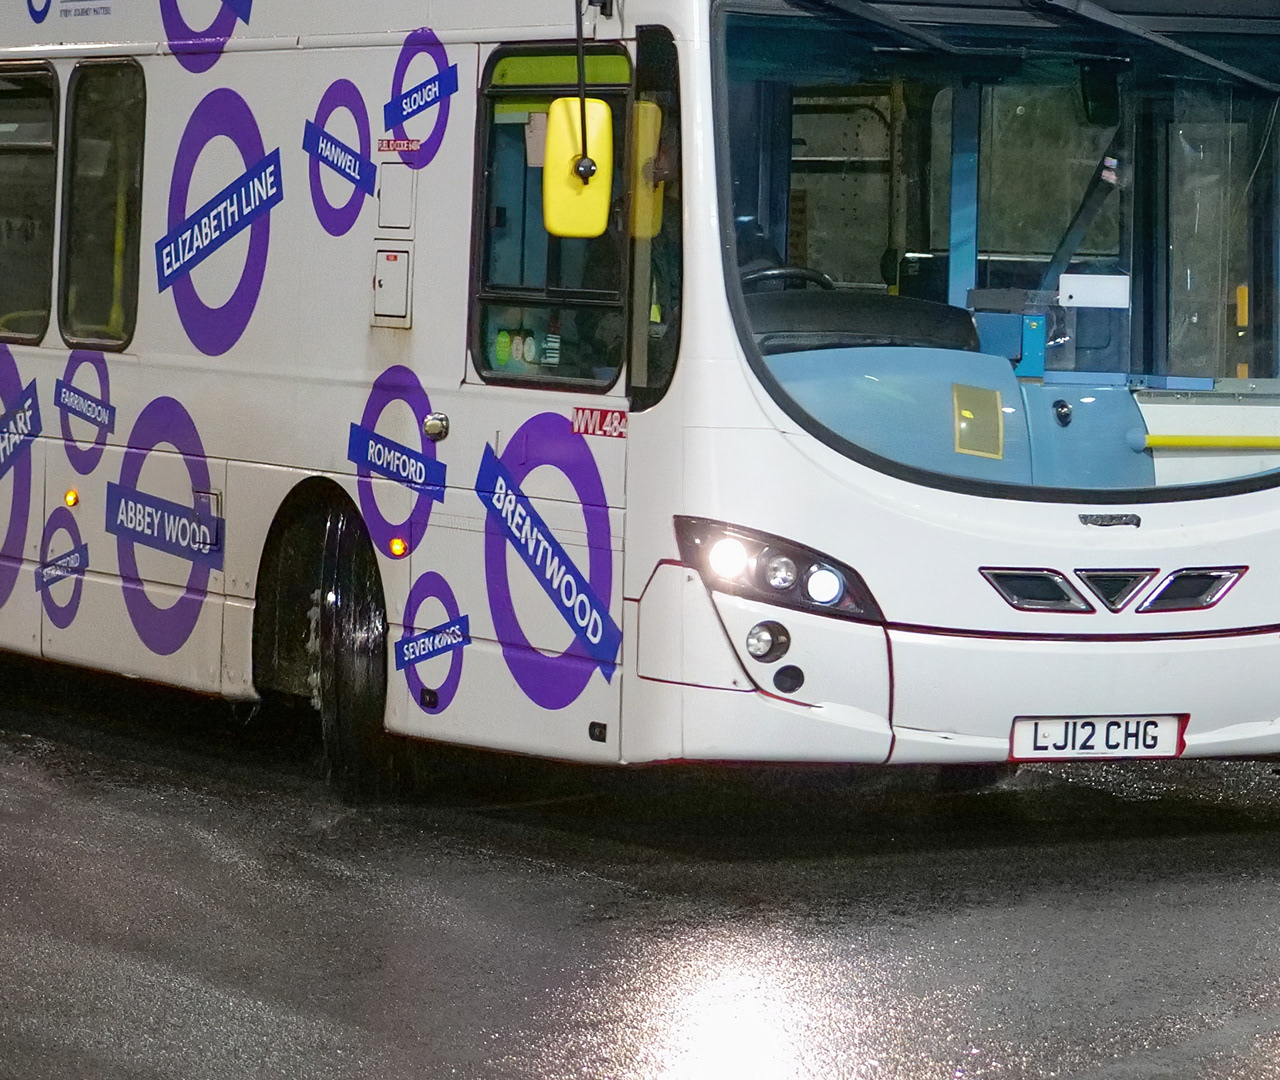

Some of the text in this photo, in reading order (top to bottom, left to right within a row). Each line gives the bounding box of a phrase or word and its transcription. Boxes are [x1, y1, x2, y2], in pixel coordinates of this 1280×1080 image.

[402, 80, 439, 115] SLOUGH
[317, 136, 361, 180] HANWELL
[162, 164, 277, 277] ELIZABETH LINE
[60, 388, 109, 424] FARRINGDON
[572, 409, 626, 437] WVL484
[368, 439, 425, 483] ROMFORD
[117, 498, 211, 553] ABBEY WOOD
[492, 476, 602, 644] BRENTWOOD
[403, 625, 463, 661] SEVEN KINGS
[1033, 721, 1159, 751] LJ12 CHG
